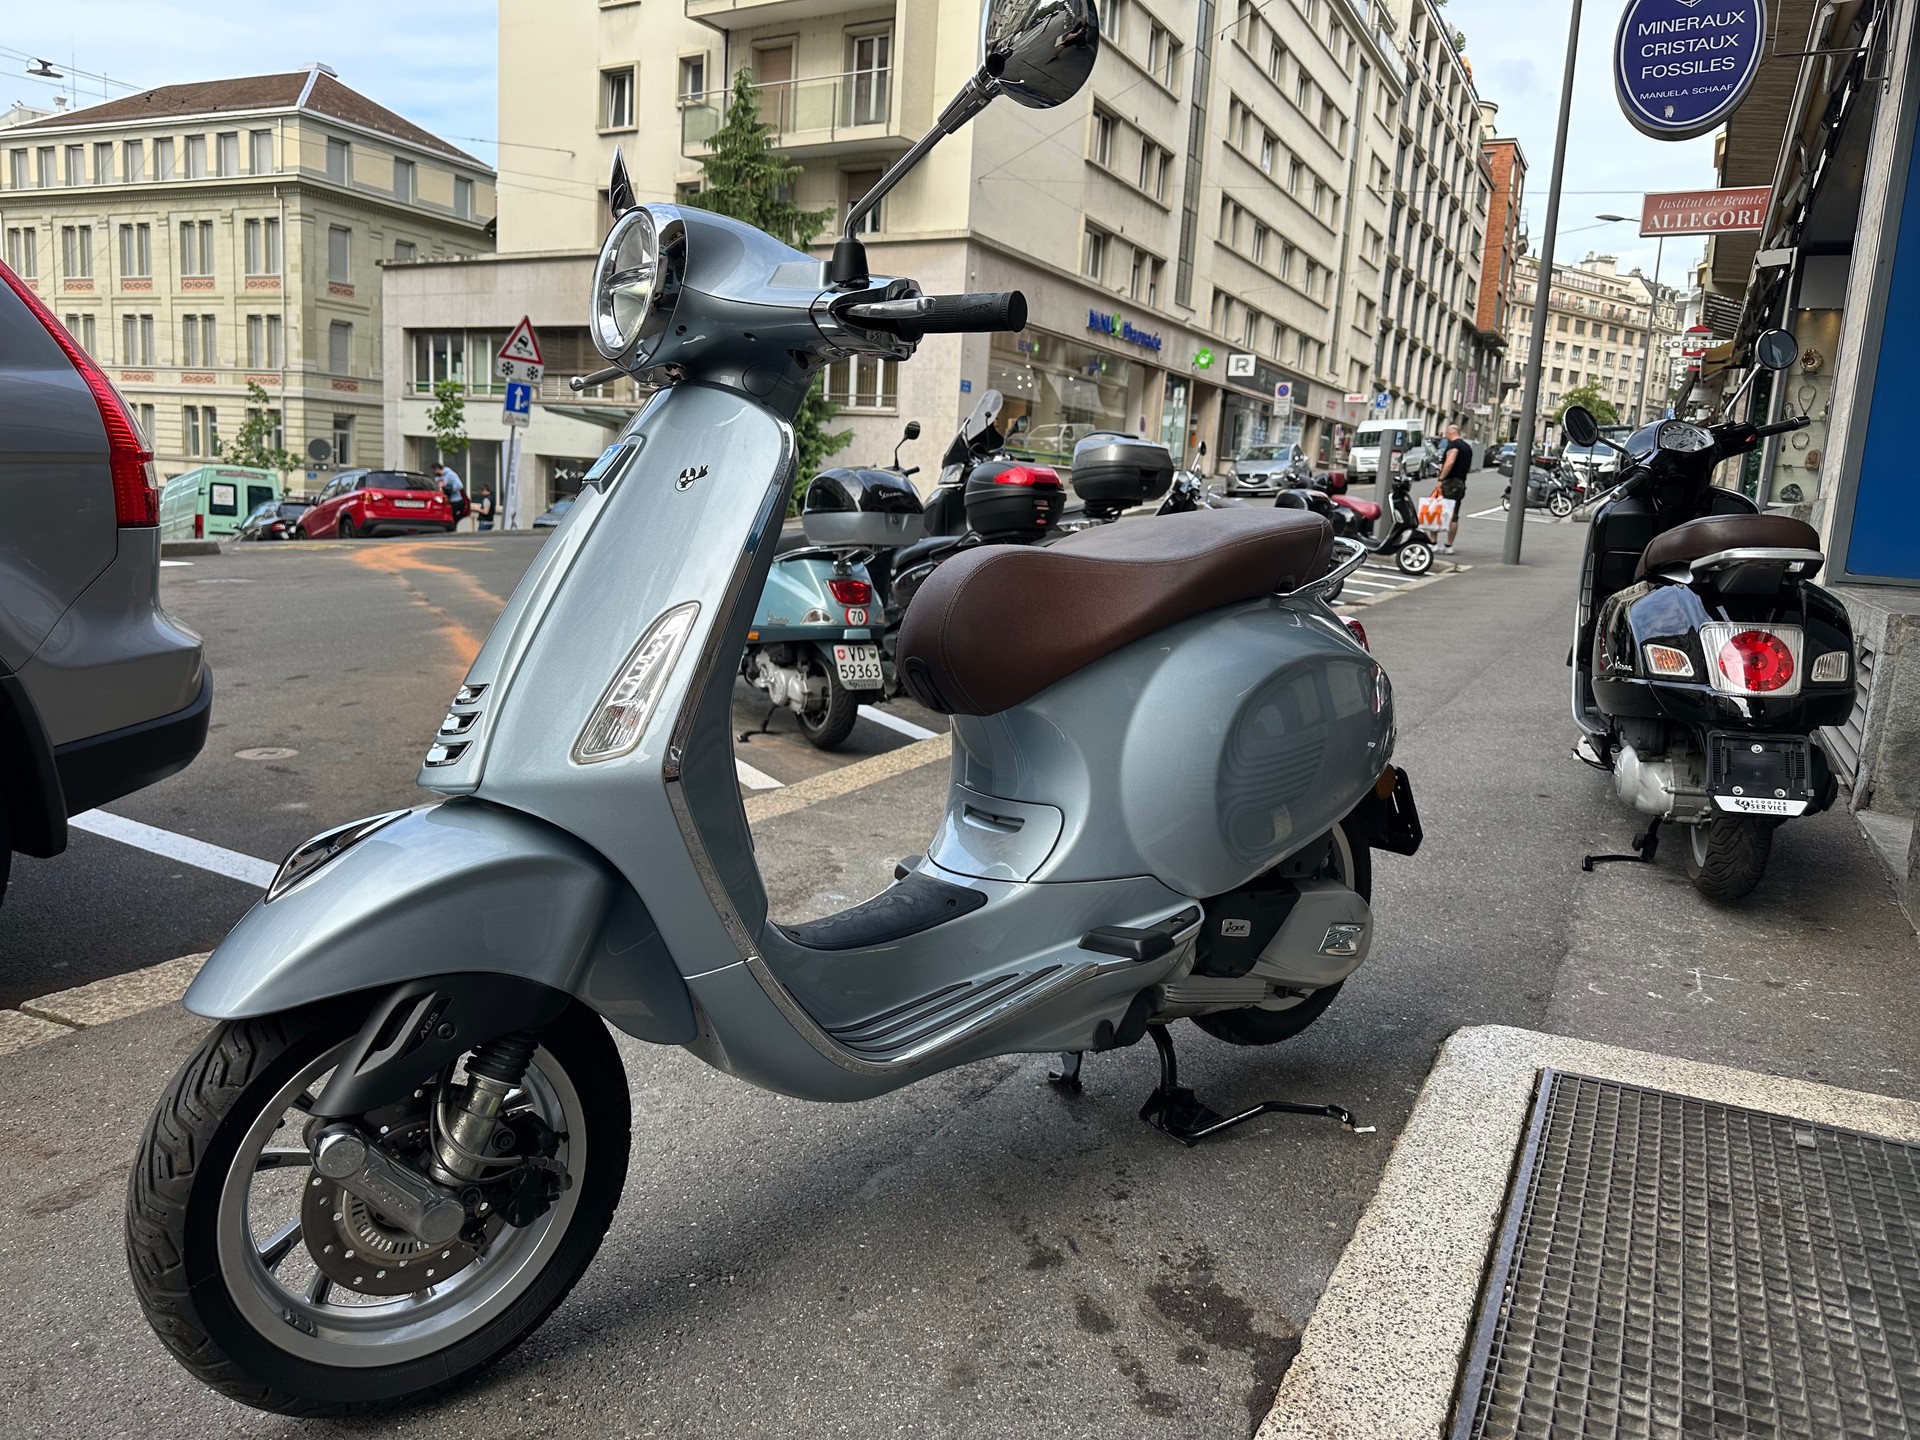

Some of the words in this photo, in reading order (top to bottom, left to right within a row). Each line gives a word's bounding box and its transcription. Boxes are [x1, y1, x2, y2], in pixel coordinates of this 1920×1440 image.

[1638, 10, 1746, 36] MINERAUX
[1641, 33, 1740, 57] CRISTAUX
[1641, 56, 1735, 79] FOSSILES
[1640, 88, 1689, 100] MANUELA
[1692, 83, 1733, 95] SCHAAF
[1658, 197, 1703, 209] Institut
[1705, 195, 1721, 207] de
[1723, 192, 1767, 205] Beauté
[1235, 358, 1250, 373] R
[1418, 504, 1442, 526] M
[851, 611, 864, 623] 70
[848, 647, 866, 662] VD
[840, 664, 881, 680] 59363
[420, 1012, 438, 1039] ABS
